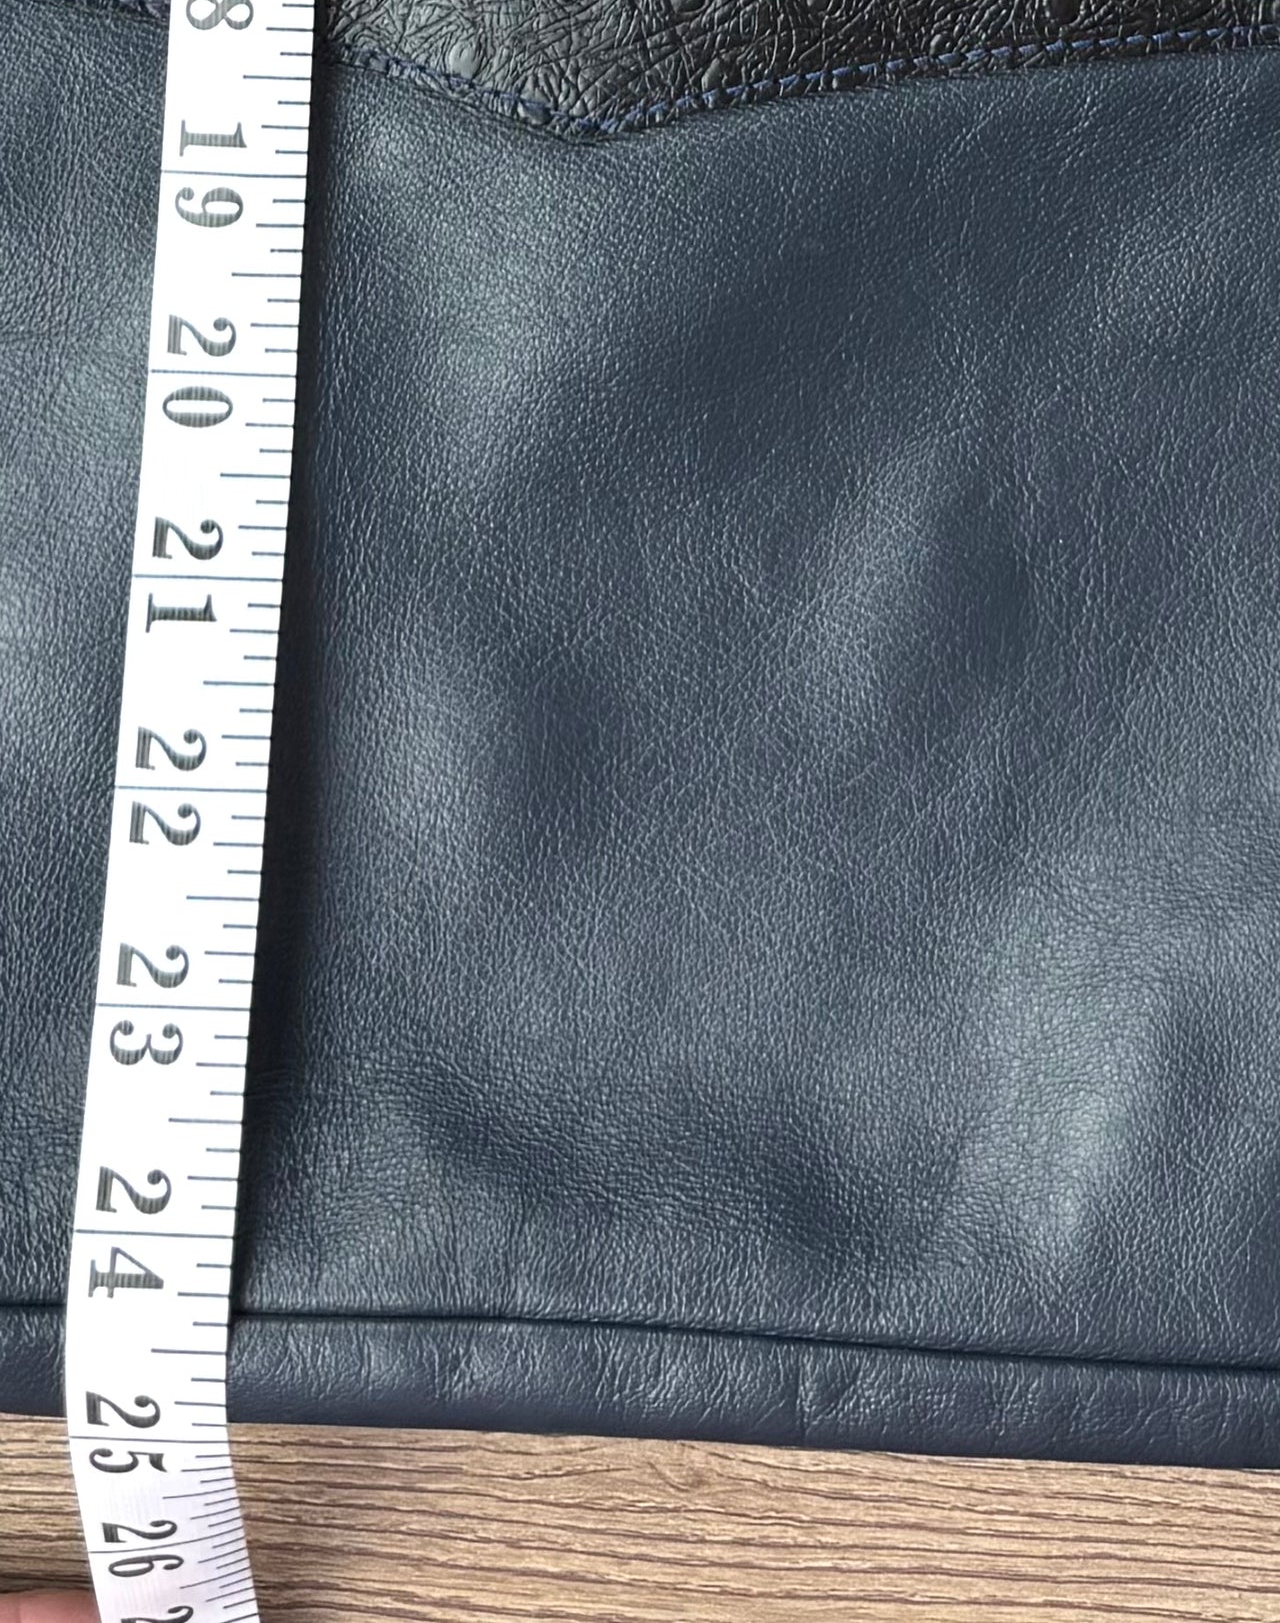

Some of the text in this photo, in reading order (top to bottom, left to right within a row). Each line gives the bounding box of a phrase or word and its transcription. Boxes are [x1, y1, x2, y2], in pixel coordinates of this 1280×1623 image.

[175, 119, 247, 228] 19
[162, 314, 237, 428] 20
[146, 516, 224, 633] 21
[129, 726, 207, 846] 22
[109, 942, 190, 1066] 23
[88, 1166, 172, 1299] 24
[86, 1391, 168, 1474] 25
[101, 1519, 184, 1578] 26
